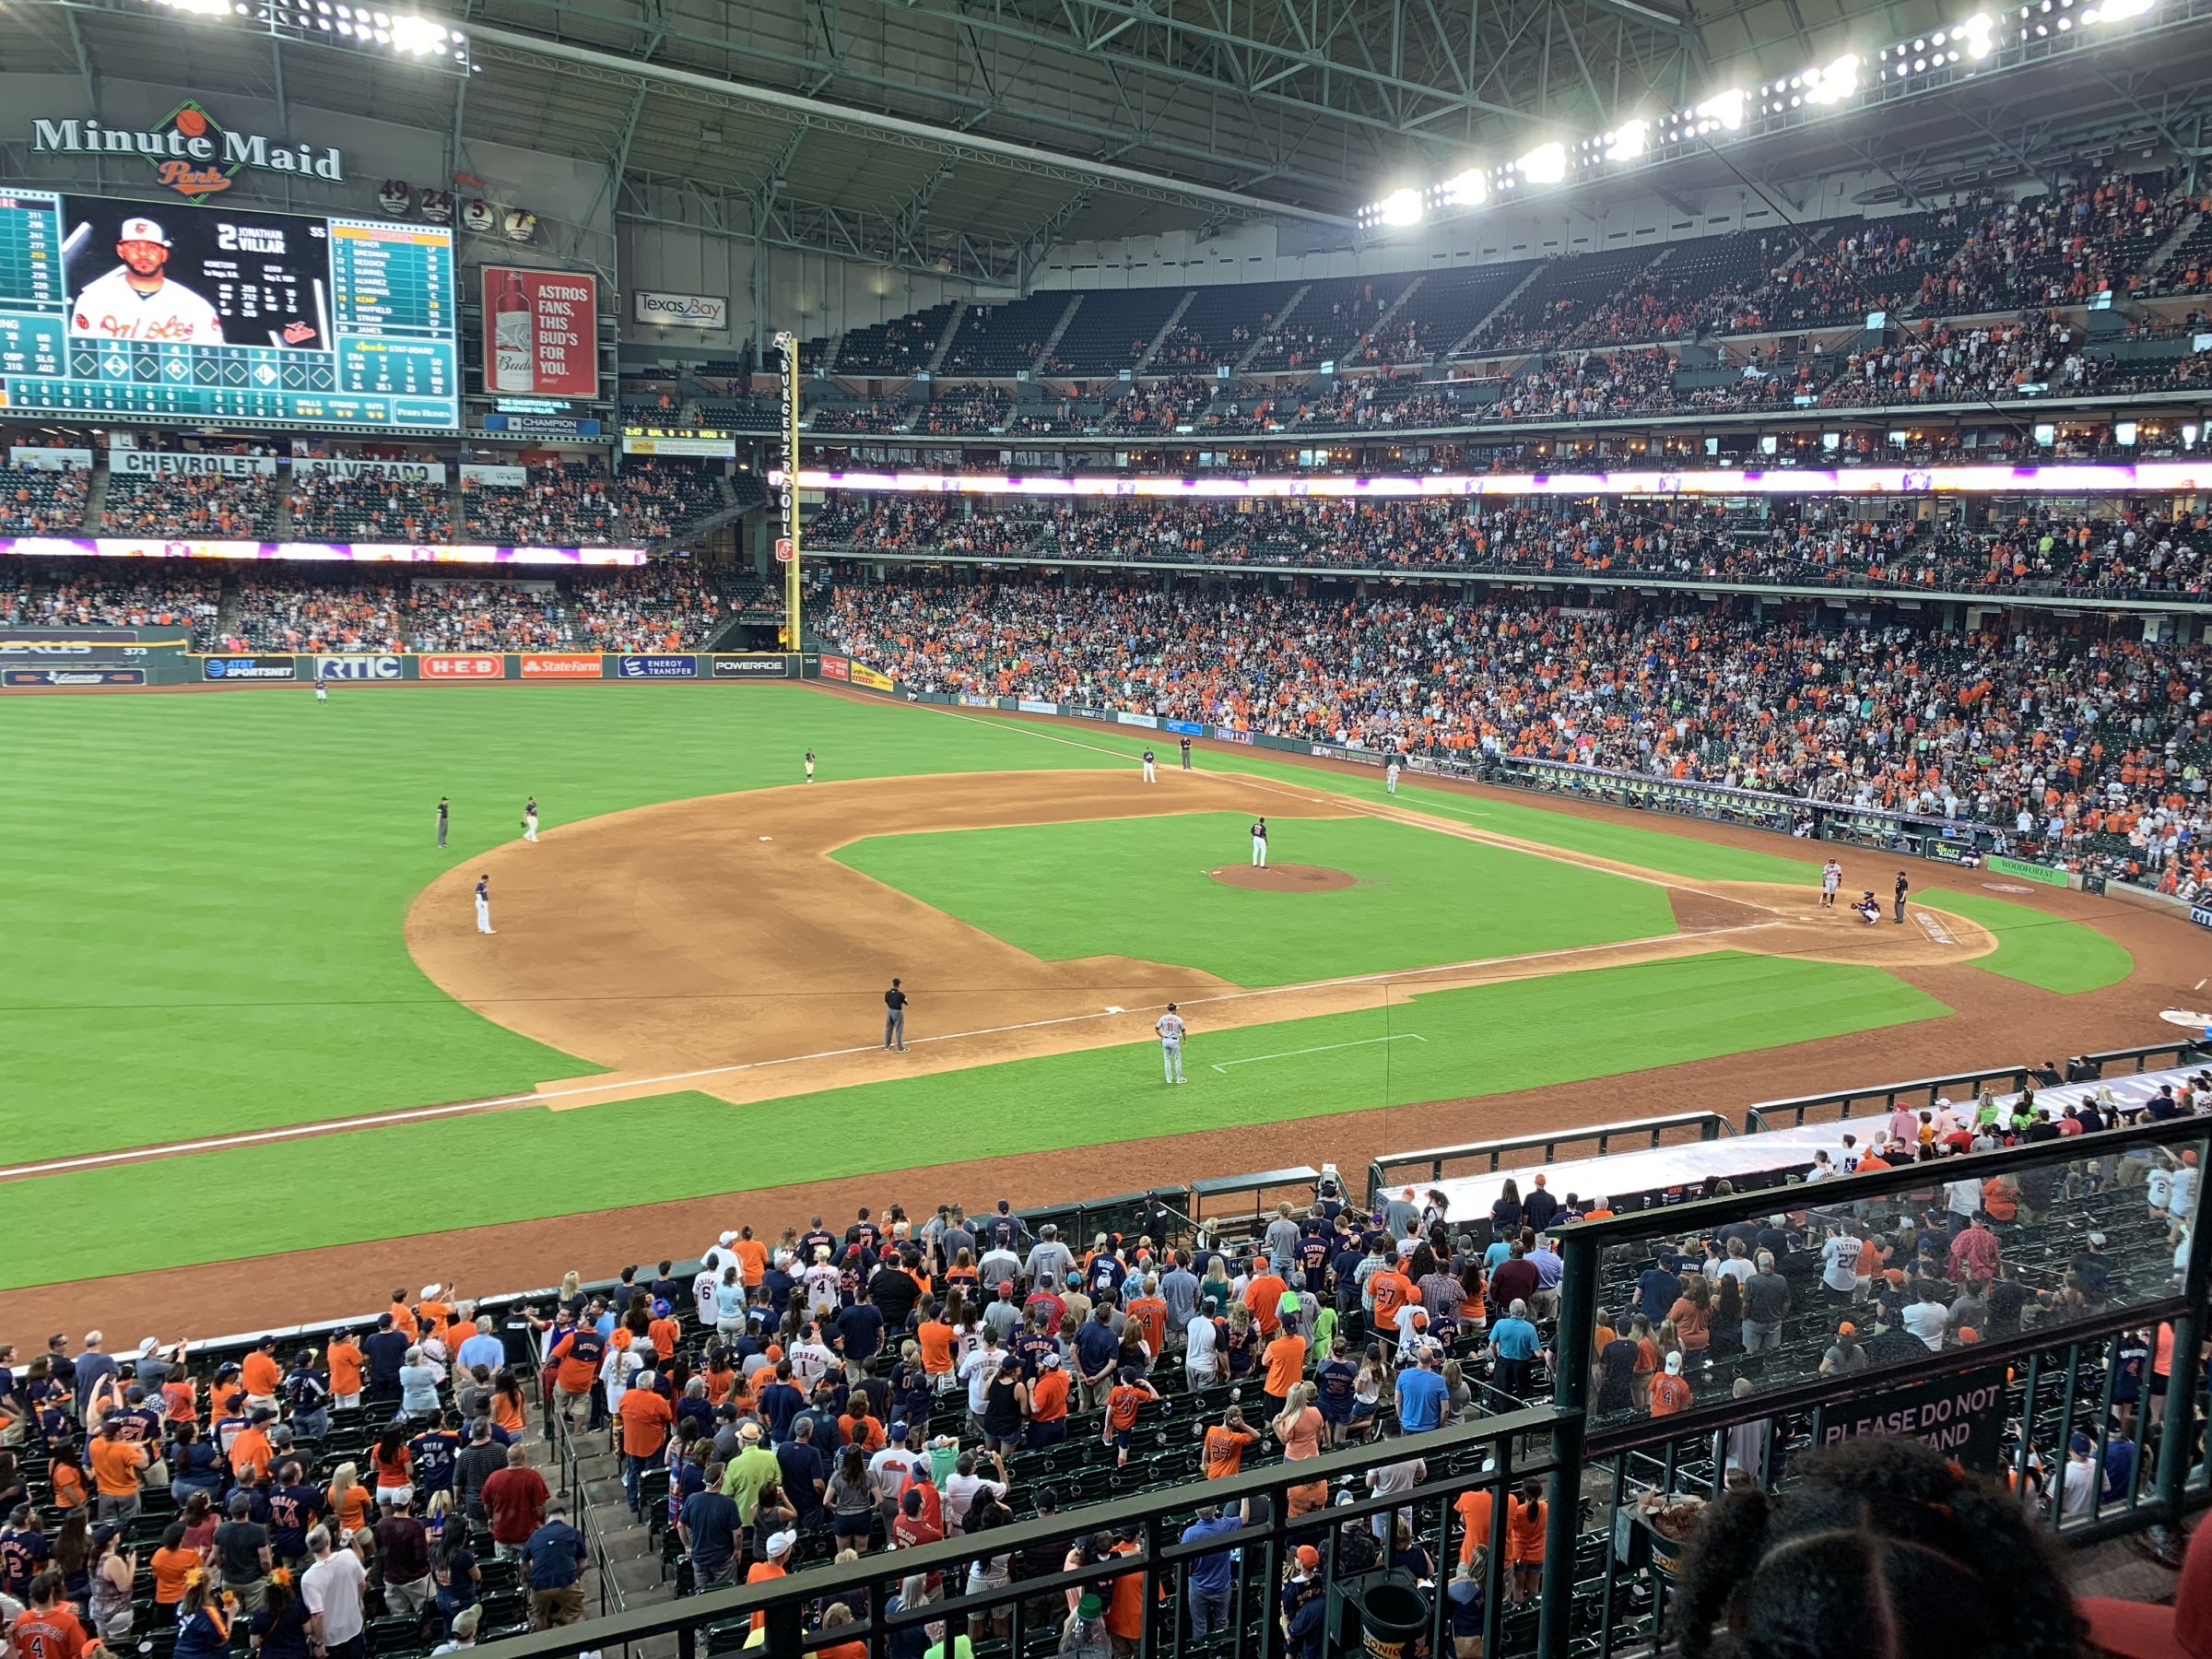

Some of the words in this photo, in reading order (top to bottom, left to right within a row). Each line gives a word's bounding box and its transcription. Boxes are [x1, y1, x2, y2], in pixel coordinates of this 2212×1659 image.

[31, 118, 213, 159] Minute
[220, 132, 344, 182] Maid
[157, 160, 232, 195] Park
[380, 180, 407, 200] 49
[422, 188, 451, 209] 24
[472, 199, 484, 218] 5
[513, 209, 525, 229] 7
[218, 224, 238, 250] 2
[238, 228, 283, 240] JONATHAN
[310, 227, 326, 238] SS
[238, 238, 286, 253] VILLAR
[353, 249, 391, 258] BREGMAN
[353, 258, 386, 267] REDDICK
[354, 268, 386, 276] GURRIEL
[354, 277, 387, 286] ALVAREZ
[355, 287, 391, 296] CHIRINOS
[538, 285, 587, 301] ASTROS
[356, 305, 393, 314] MAYFIELD
[538, 300, 574, 317] FANS,
[641, 294, 685, 313] Texas
[689, 298, 721, 317] Bay
[538, 315, 568, 330] THIS
[357, 326, 383, 335] JAMES
[80, 340, 87, 348] 1
[539, 332, 578, 347] BUD'S
[110, 342, 119, 351] 2
[141, 344, 148, 352] 3
[171, 346, 180, 354] 4
[201, 347, 209, 356] 5
[35, 355, 55, 363] SLG
[259, 351, 268, 360] 7
[288, 353, 296, 361] 8
[316, 355, 324, 363] 9
[347, 353, 365, 361] ERA
[539, 347, 565, 360] FOR
[539, 361, 570, 375] YOU.
[430, 377, 444, 385] BB
[523, 418, 576, 429] CHAMPION
[631, 442, 654, 451] smile
[125, 454, 261, 475] CHEVROLET
[227, 660, 256, 668] AT&T
[317, 656, 398, 678] RTIC
[432, 661, 492, 672] H-E-B
[715, 661, 782, 670] POWERADE
[225, 667, 292, 677] SPORTSNET
[2001, 860, 2053, 878] WOODFOREST
[2157, 1182, 2165, 1194] 2
[1303, 1245, 1326, 1253] ALTUVE
[1836, 1244, 1860, 1253] ALTUVE
[1097, 1260, 1114, 1271] BIGGIO
[1307, 1253, 1324, 1268] 27
[1681, 1262, 1700, 1271] ALTUVE
[1837, 1254, 1858, 1268] 27
[817, 1280, 826, 1294] 4
[702, 1287, 711, 1300] 6
[1378, 1288, 1395, 1305] 27
[1133, 1305, 1164, 1317] SPRINGER
[1142, 1314, 1152, 1328] 4
[968, 1337, 978, 1351] 2
[1023, 1342, 1053, 1351] CORREA
[1443, 1334, 1451, 1347] 3
[792, 1353, 820, 1363] CORREA
[801, 1361, 807, 1377] 1
[1663, 1390, 1673, 1404] 4
[1122, 1402, 1130, 1413] 4
[1826, 1407, 1916, 1446] PLEASE
[1921, 1399, 1951, 1427] DO
[1955, 1384, 2000, 1417] NOT
[1916, 1422, 1971, 1453] TAND
[422, 1442, 444, 1452] RYAN
[1212, 1445, 1230, 1462] 27
[423, 1452, 450, 1468] 34
[896, 1526, 917, 1546] BIGGIO
[9, 1558, 23, 1577] 2
[29, 1637, 44, 1658] 4
